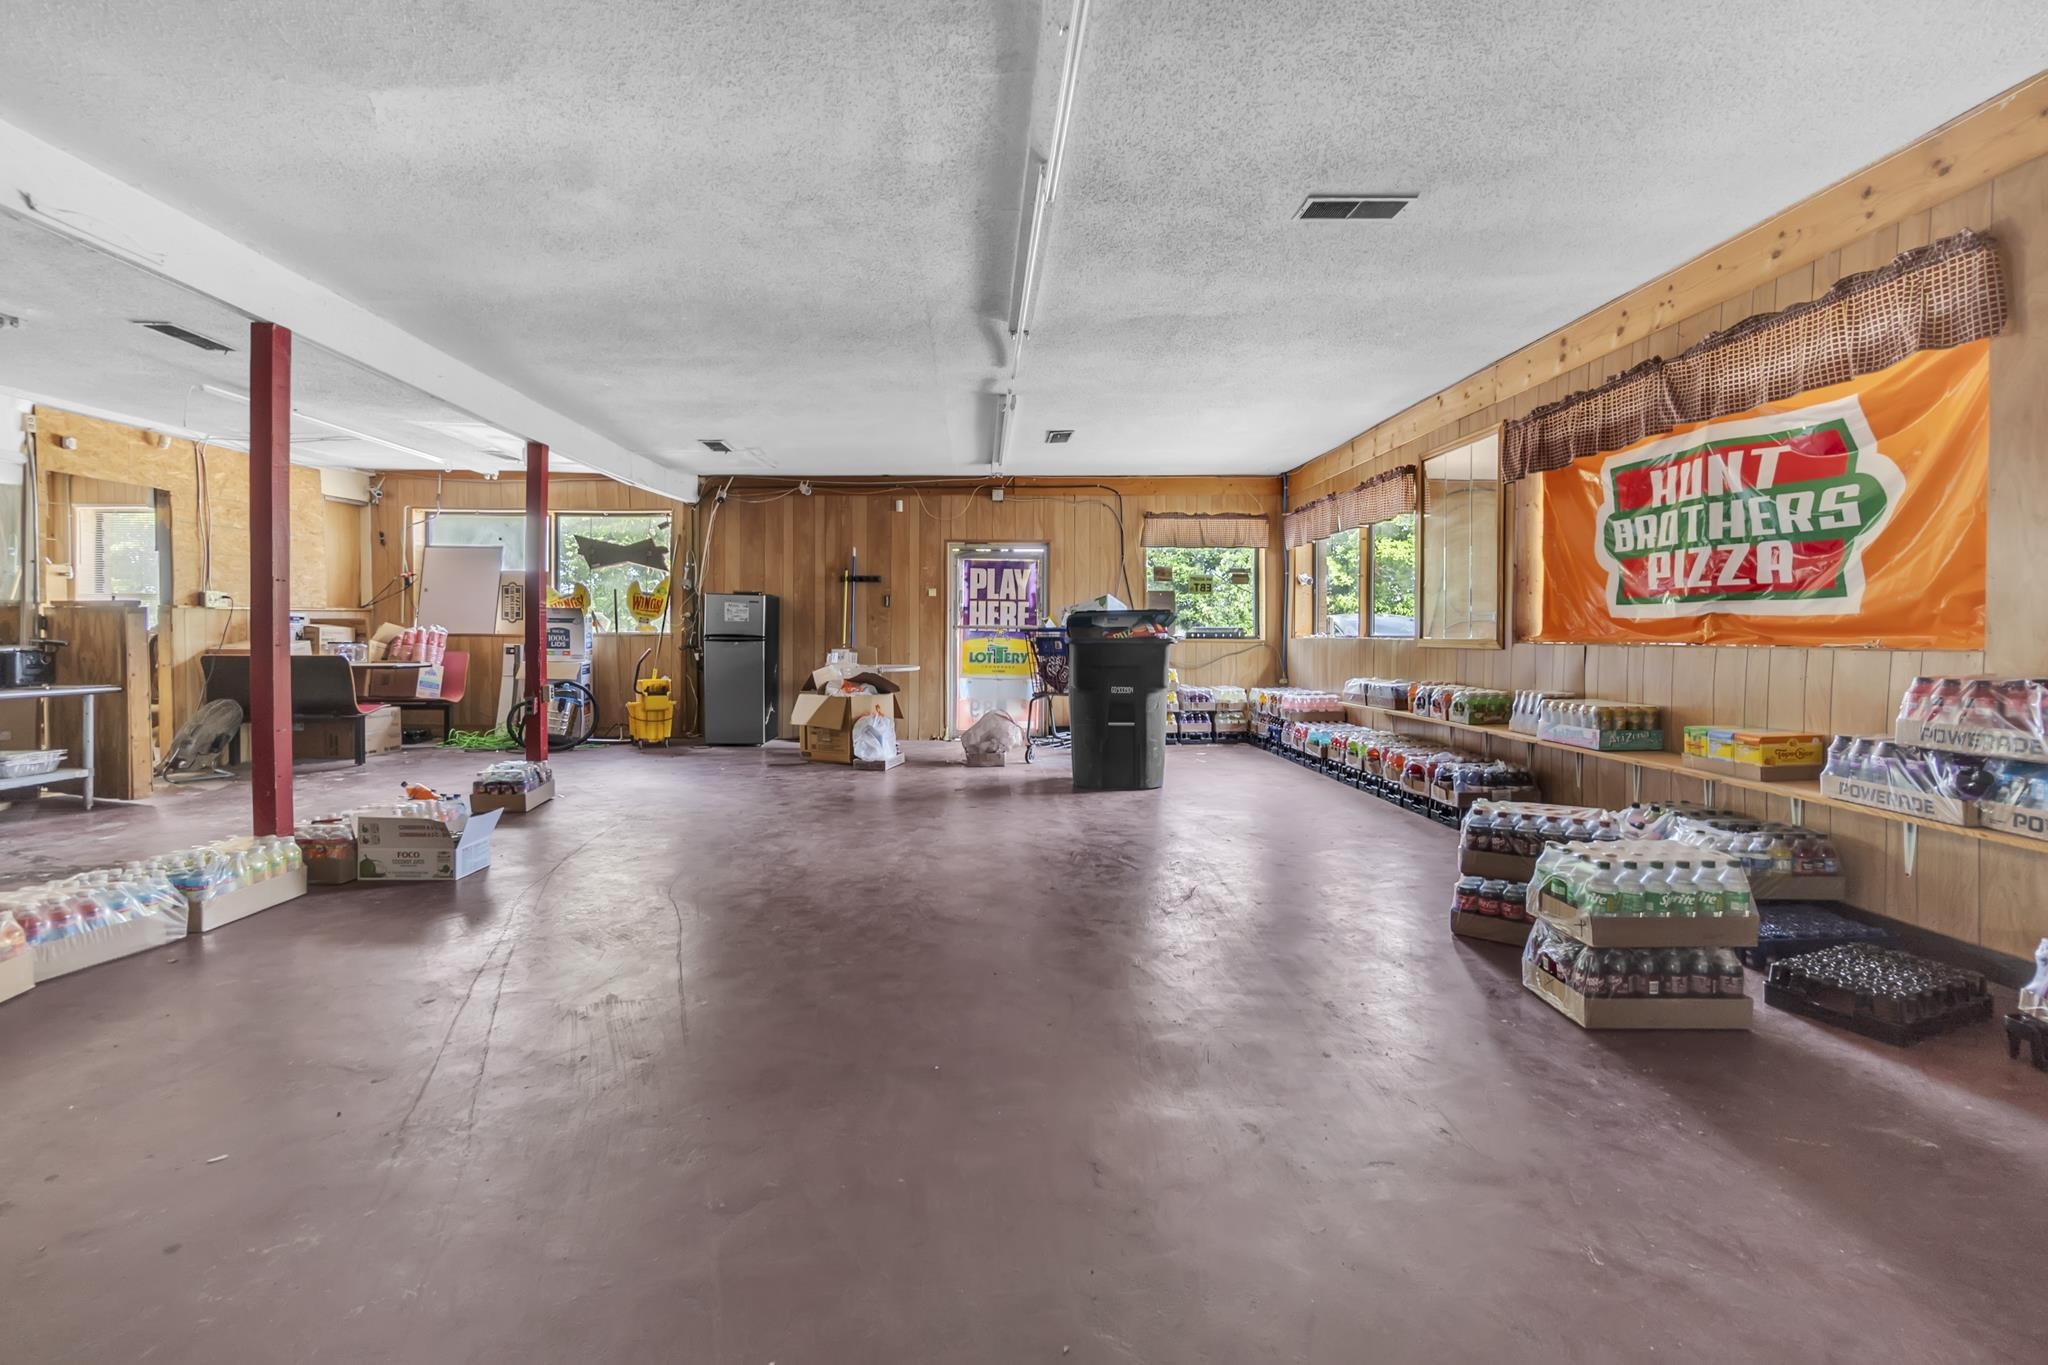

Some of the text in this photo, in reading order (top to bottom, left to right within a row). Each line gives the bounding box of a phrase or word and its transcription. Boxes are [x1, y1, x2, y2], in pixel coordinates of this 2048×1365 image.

[1650, 446, 1791, 508] HUNT
[1613, 484, 1862, 552] BROTHERS
[1647, 540, 1794, 590] PIZZA
[969, 567, 1031, 600] PLAY
[969, 601, 1030, 632] HERE
[969, 645, 1028, 664] LOTTERY
[1920, 727, 2042, 754] POWERADE
[1840, 781, 1935, 815] POWERADE
[2013, 812, 2048, 834] PO
